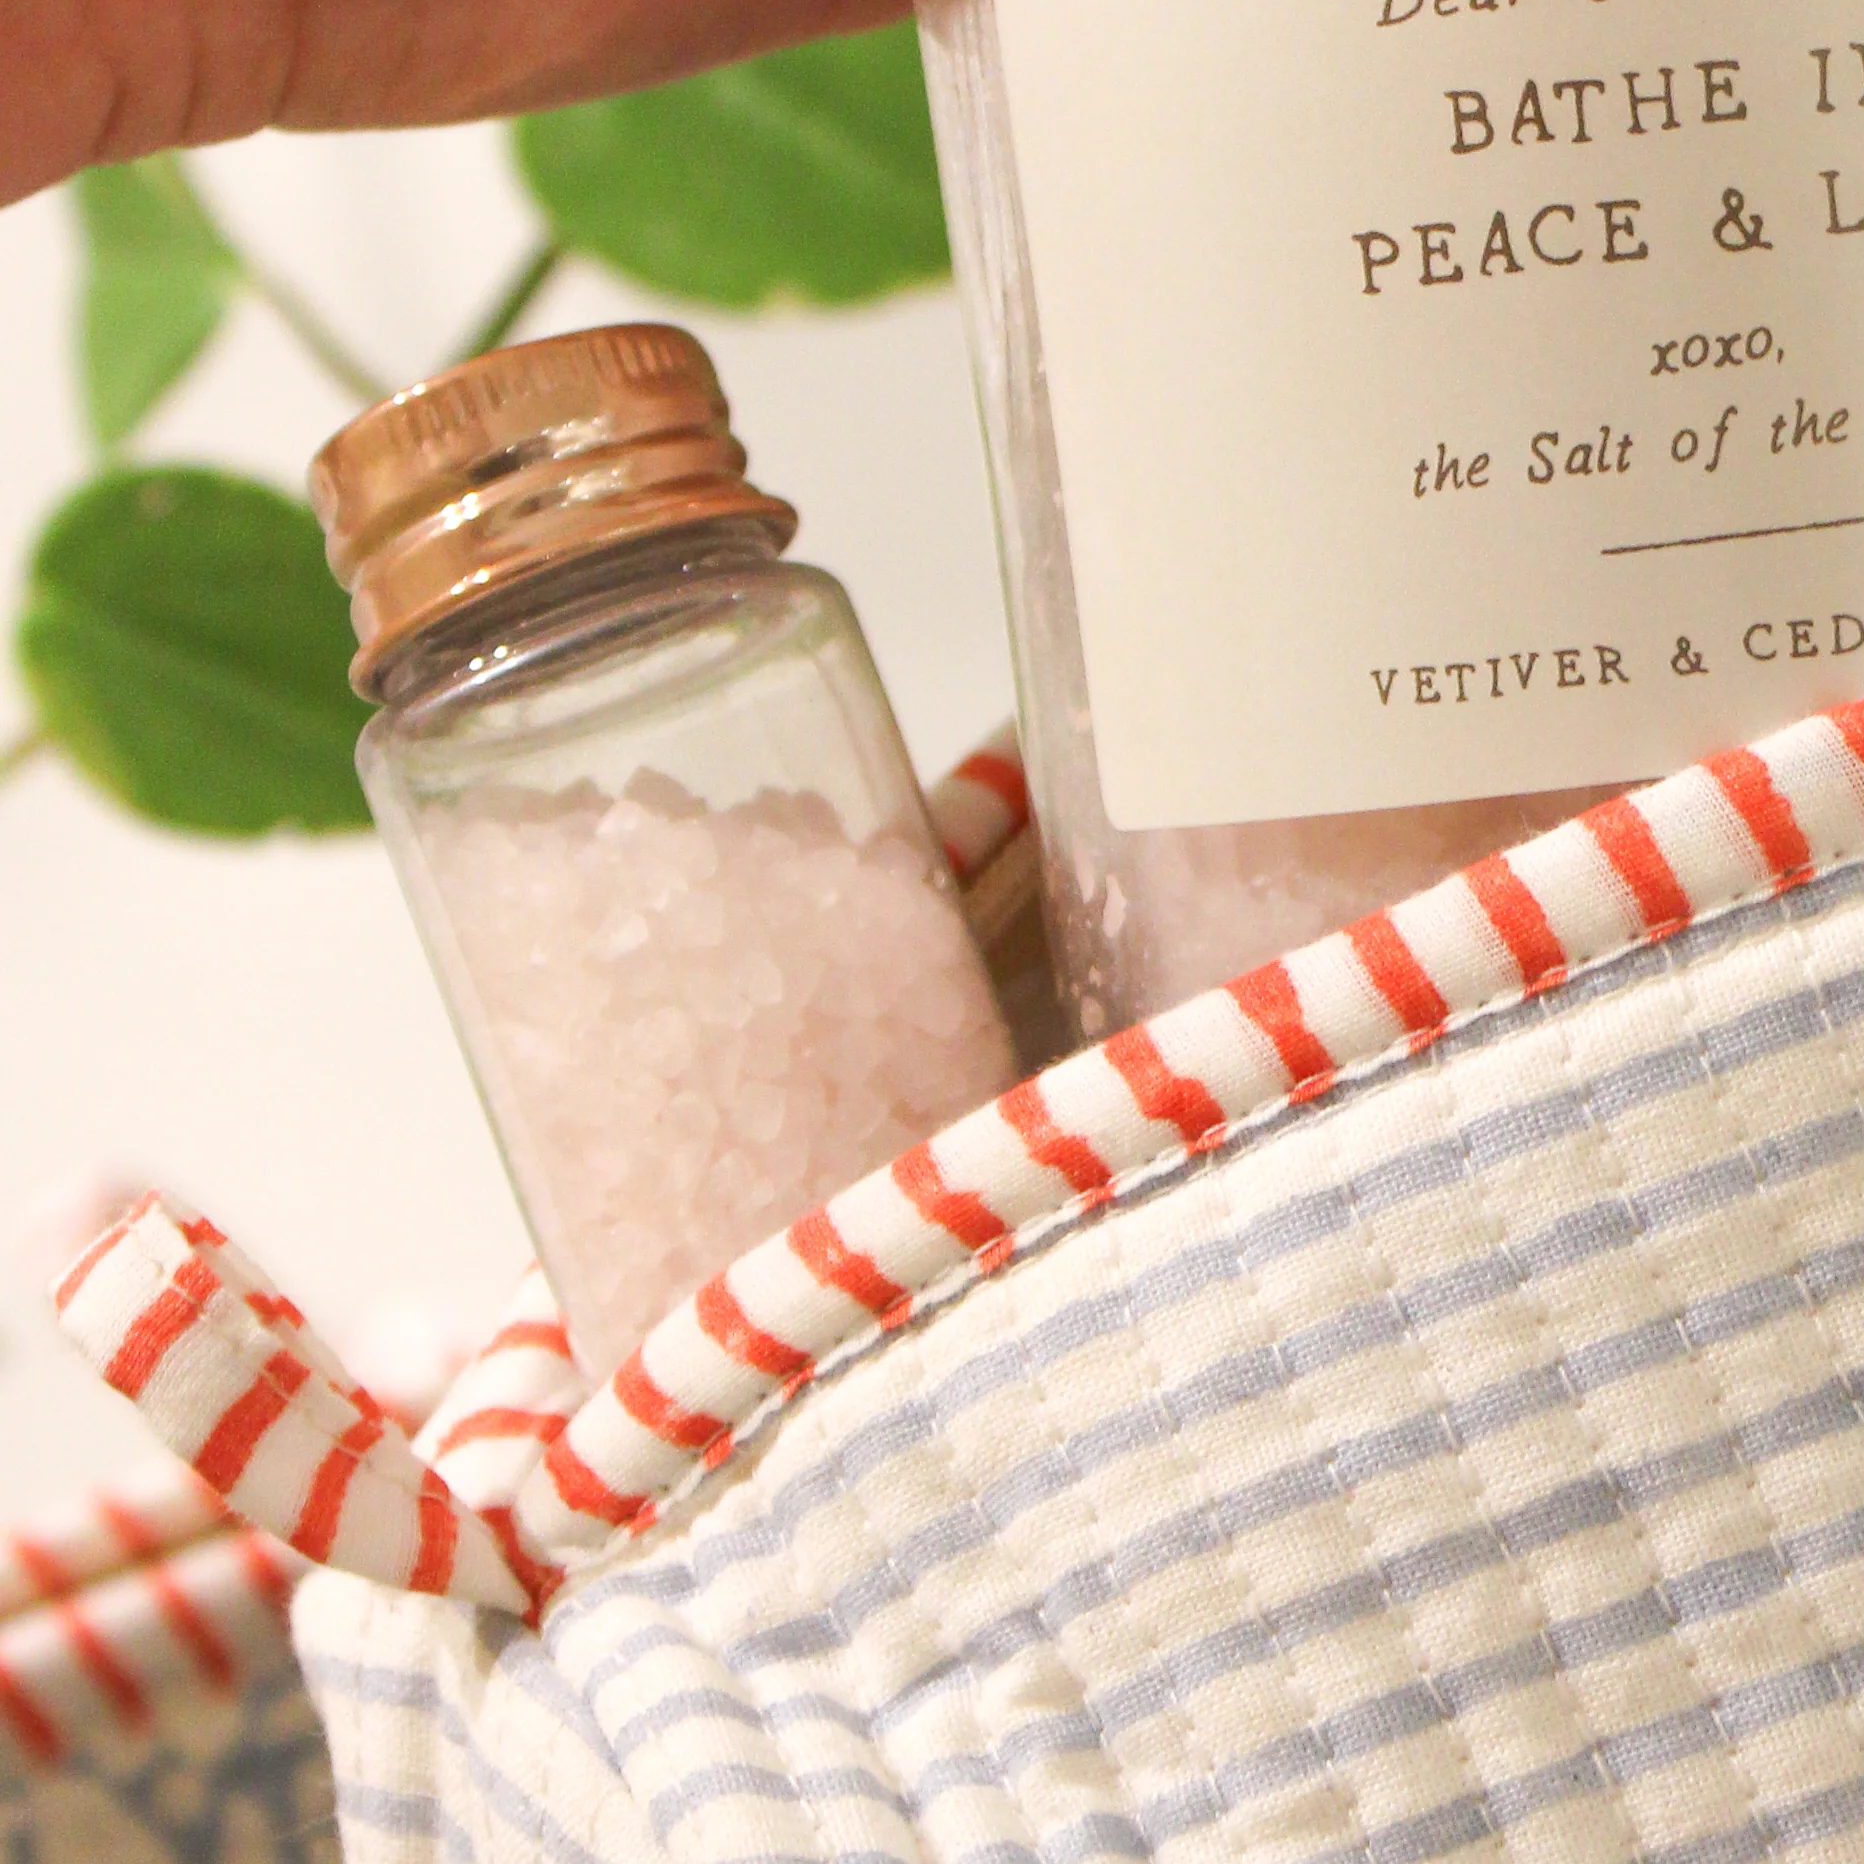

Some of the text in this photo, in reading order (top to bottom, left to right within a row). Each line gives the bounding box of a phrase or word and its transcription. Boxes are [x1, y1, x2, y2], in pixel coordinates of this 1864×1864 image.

[1445, 58, 1748, 155] BATHE
[1352, 198, 1650, 295] PEACE
[1713, 186, 1773, 252] &
[1649, 324, 1786, 377] xoxo,
[1412, 442, 1491, 497] the
[1527, 423, 1632, 486] Salt
[1670, 406, 1738, 472] of
[1770, 399, 1849, 455] the
[1370, 644, 1632, 707] VETIVER
[1670, 636, 1709, 675] &
